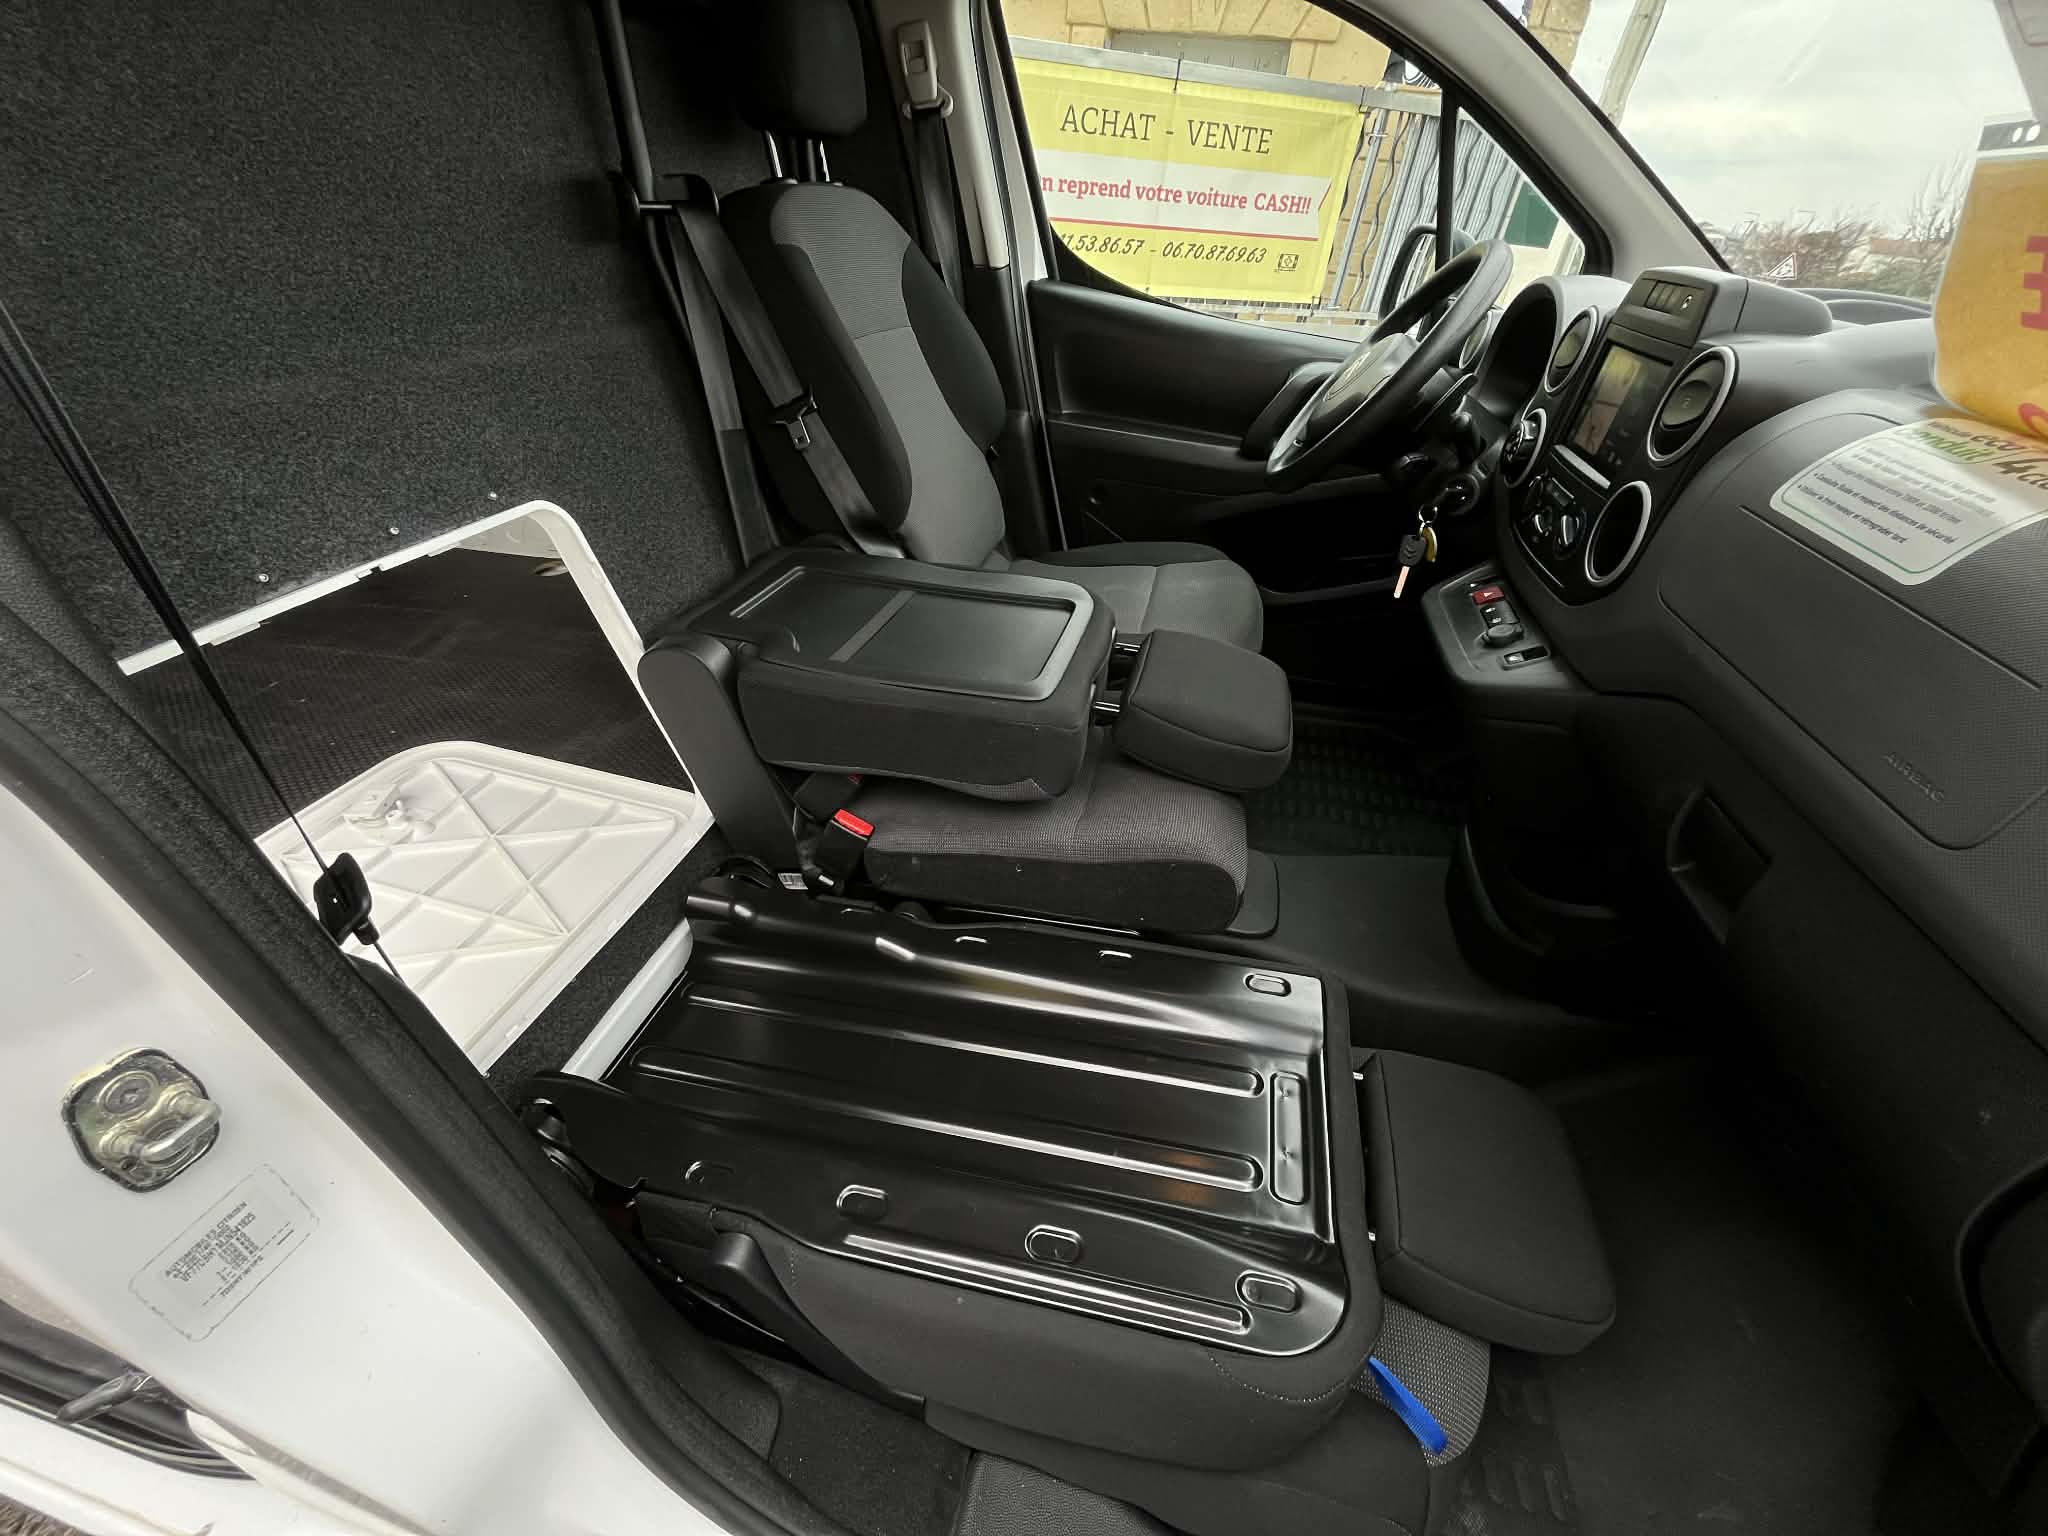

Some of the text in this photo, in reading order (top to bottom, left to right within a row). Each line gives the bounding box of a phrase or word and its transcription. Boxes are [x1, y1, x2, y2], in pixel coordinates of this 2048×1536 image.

[1060, 103, 1156, 141] ACHAT
[1187, 119, 1273, 155] VENTE
[1040, 176, 1311, 215] n reprend votre voiture CASH!!
